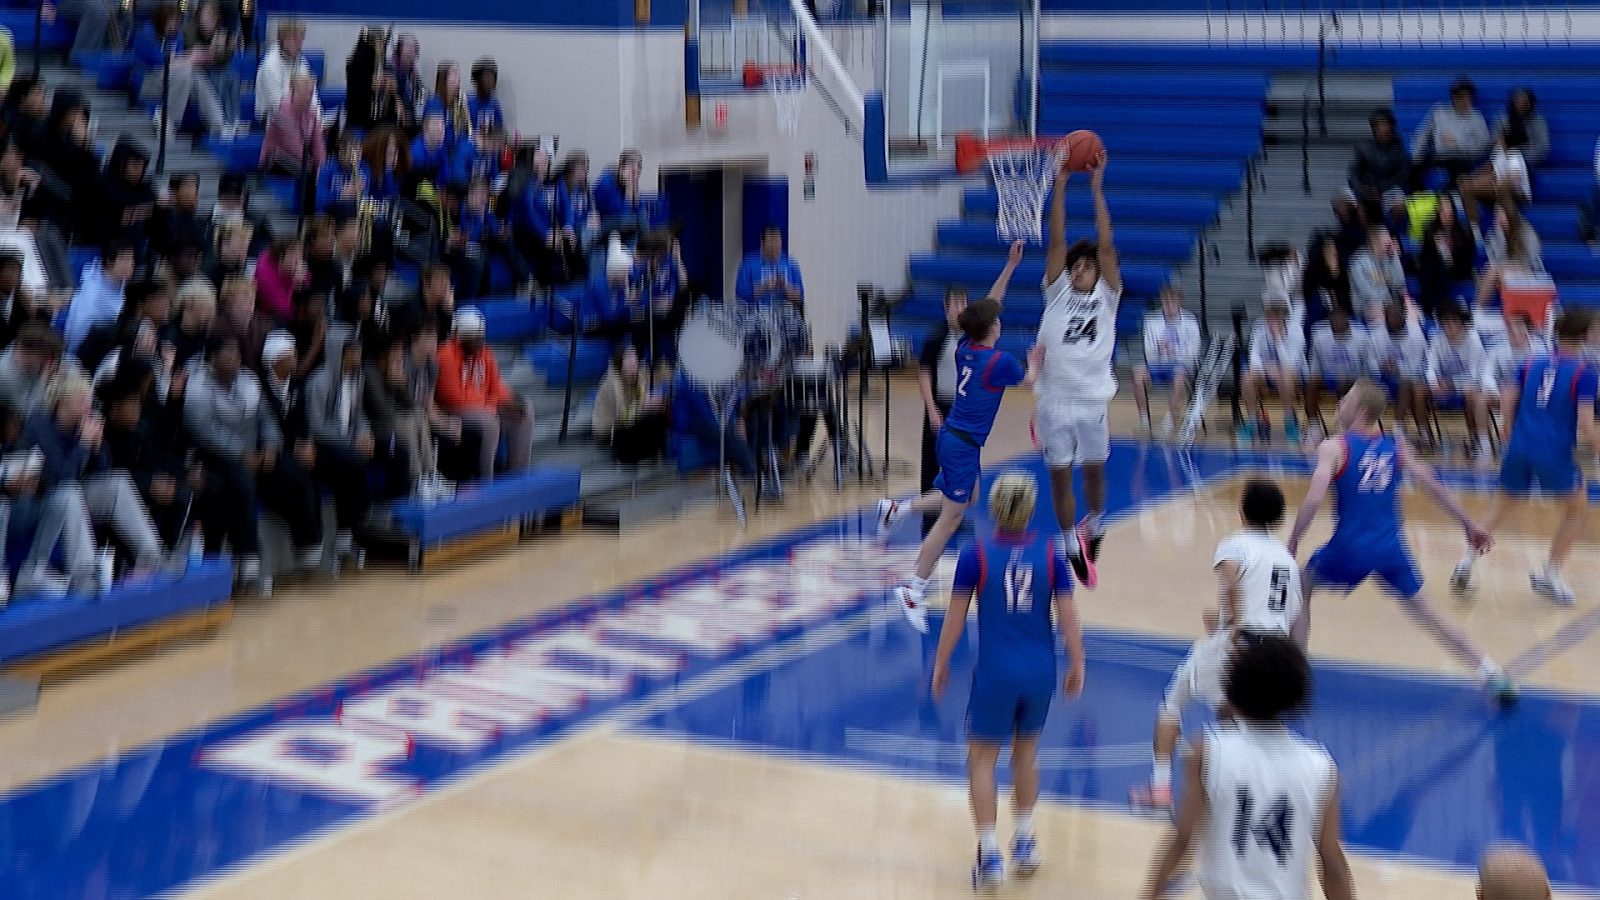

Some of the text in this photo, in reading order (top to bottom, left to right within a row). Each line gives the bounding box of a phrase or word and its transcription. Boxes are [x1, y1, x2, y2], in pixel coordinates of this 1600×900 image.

[1062, 315, 1098, 345] 24
[958, 365, 973, 398] 2
[1004, 562, 1034, 614] 12
[1268, 565, 1291, 613] 5
[1232, 785, 1294, 867] 14
